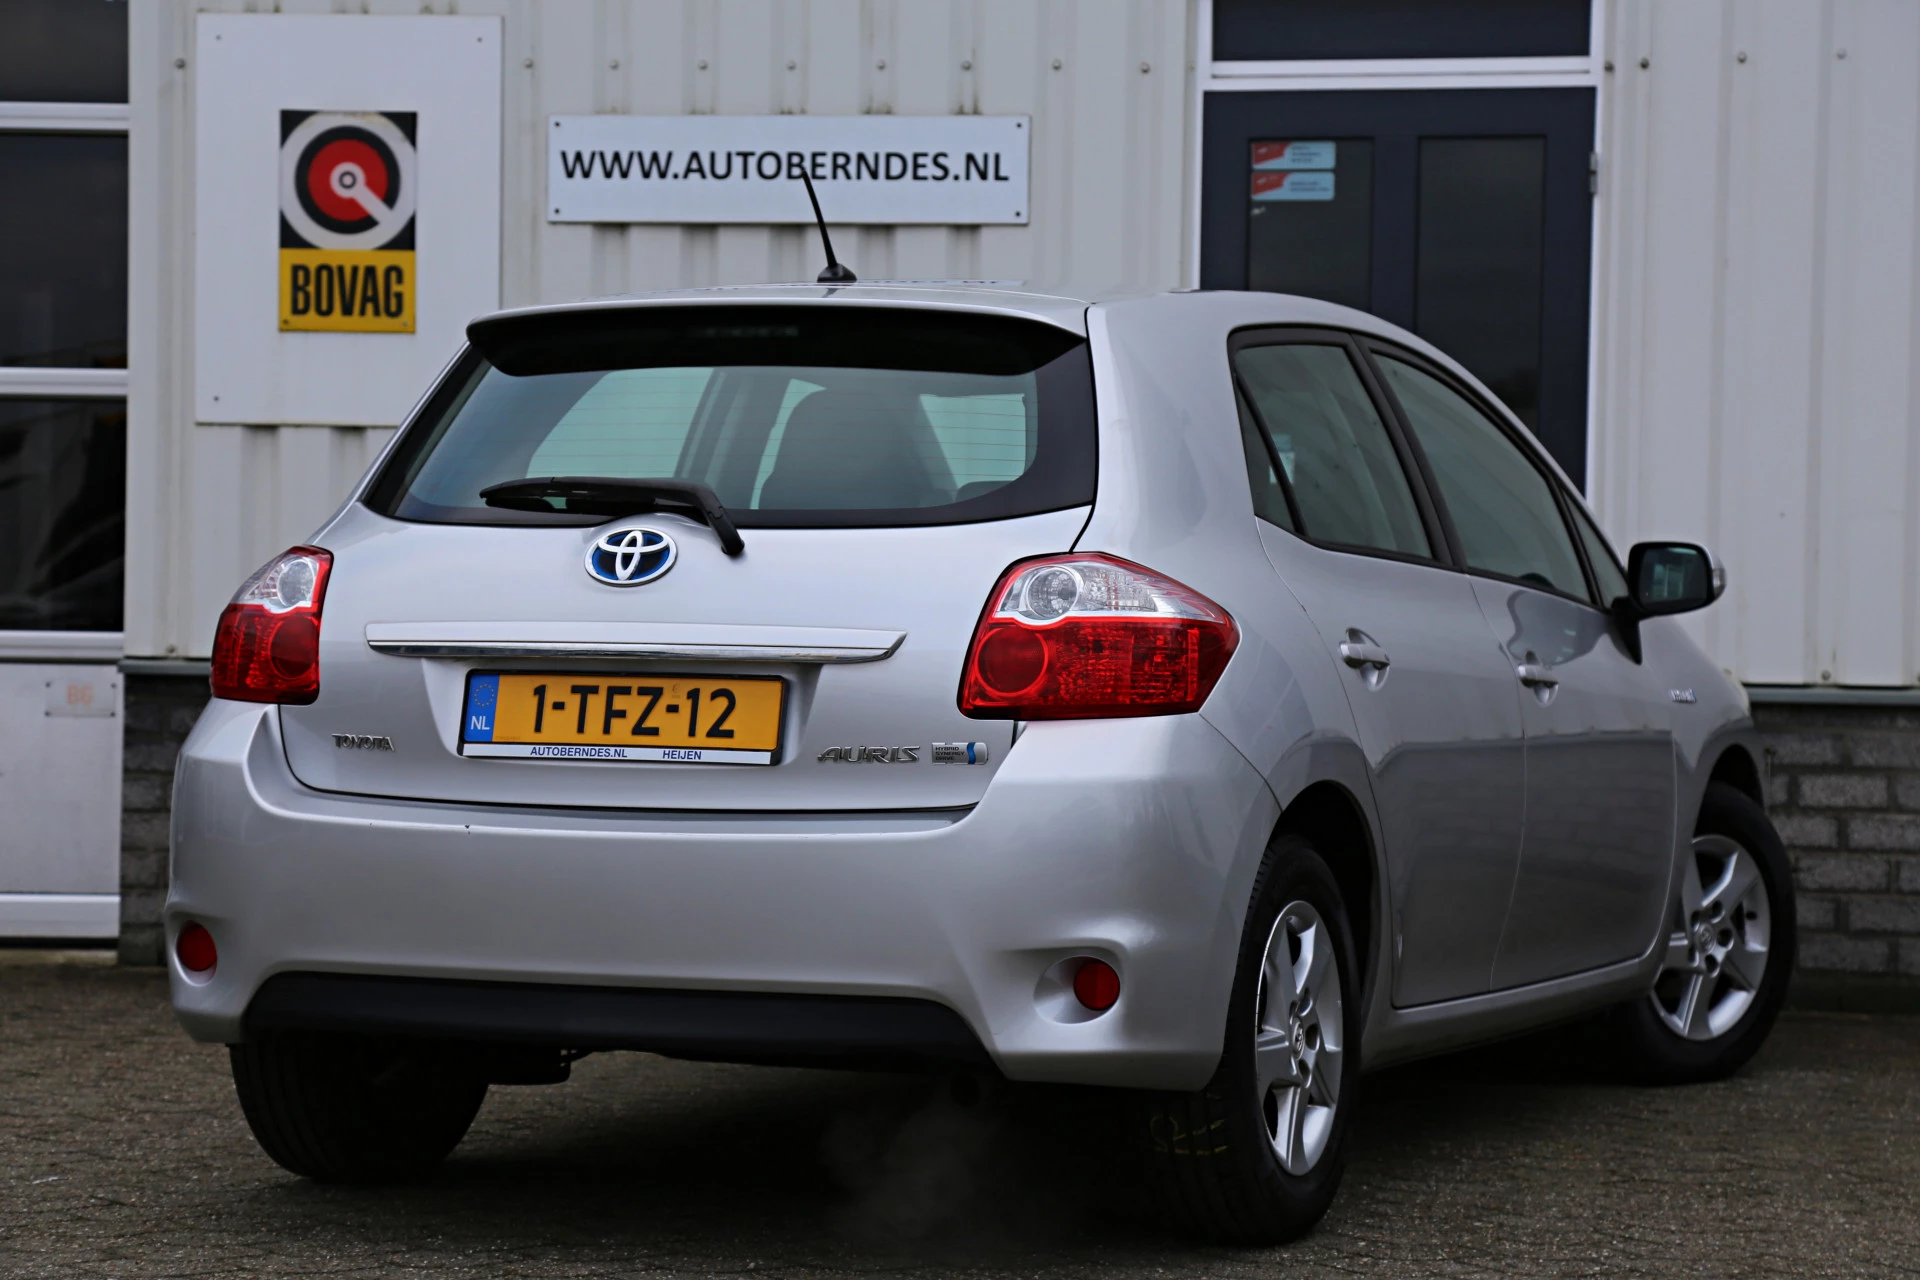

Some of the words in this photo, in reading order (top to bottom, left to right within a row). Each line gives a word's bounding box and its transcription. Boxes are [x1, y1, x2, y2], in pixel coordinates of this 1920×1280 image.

[560, 150, 1010, 182] WWW.AUTOBERNDES.NL
[290, 263, 405, 318] BOVAG
[533, 683, 737, 738] 1-TFZ-12
[470, 715, 490, 731] NL
[331, 733, 394, 751] TOYOTA
[530, 746, 628, 759] AUTOBERNDES.NL
[662, 749, 702, 760] HEIJEN
[817, 745, 920, 763] AURIS
